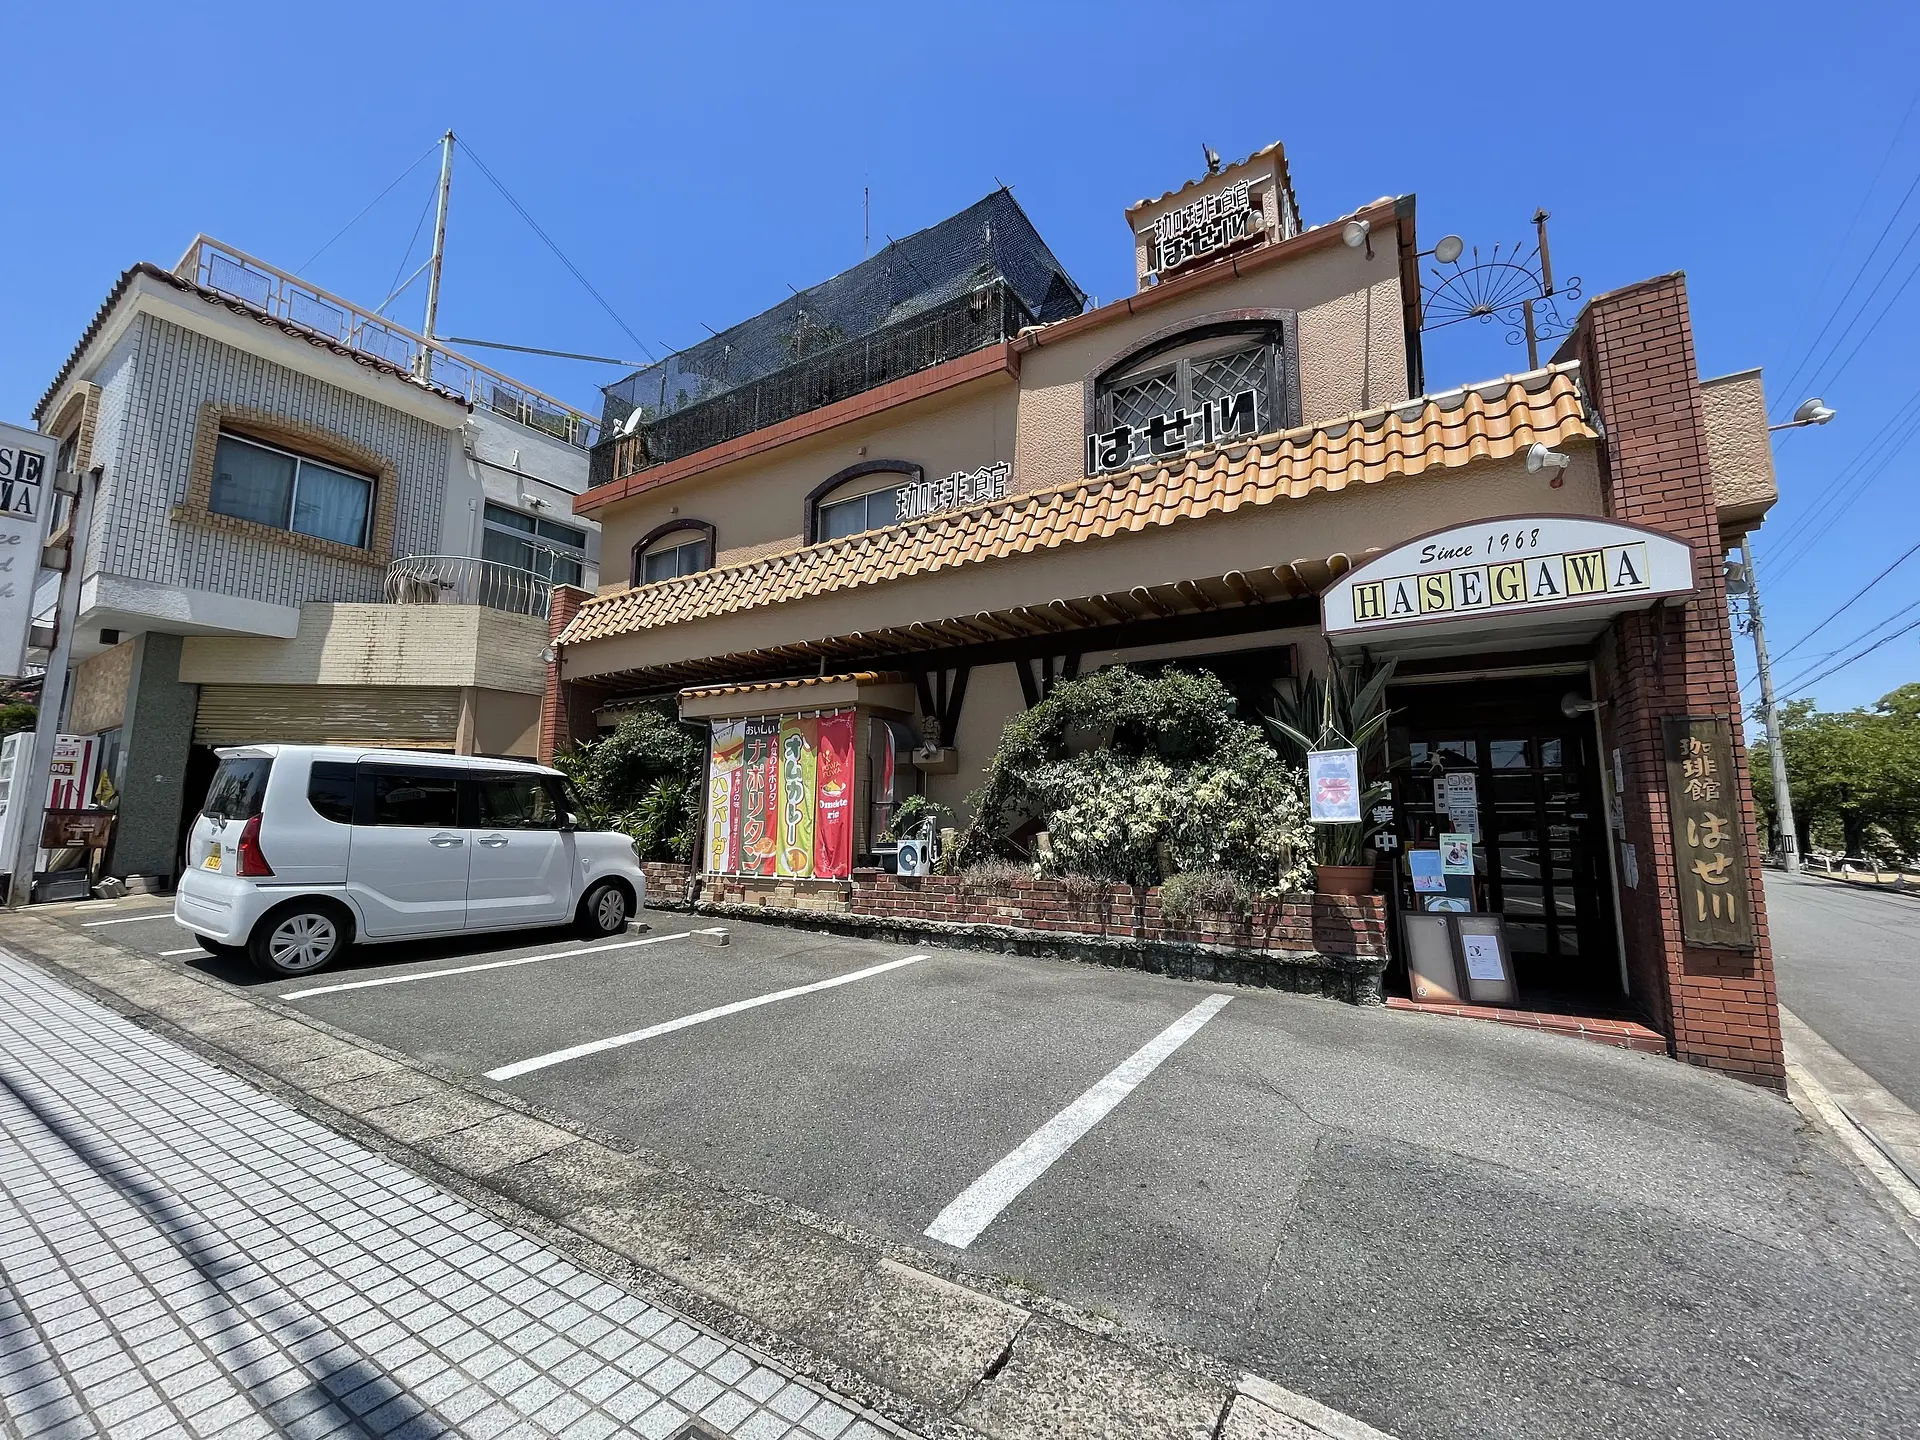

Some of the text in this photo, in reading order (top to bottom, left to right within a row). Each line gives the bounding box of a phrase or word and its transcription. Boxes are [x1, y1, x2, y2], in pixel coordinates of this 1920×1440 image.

[1155, 180, 1249, 243] 珈琲館
[895, 461, 1012, 520] 珈琲館
[1419, 528, 1541, 564] Since 1968
[1357, 550, 1644, 618] HASEGAWA
[742, 739, 767, 871] ナポリタン
[768, 738, 778, 811] 人気のナポリタン
[711, 777, 729, 871] ハンバーガー
[1679, 736, 1736, 924] 珈琲館 はせ川
